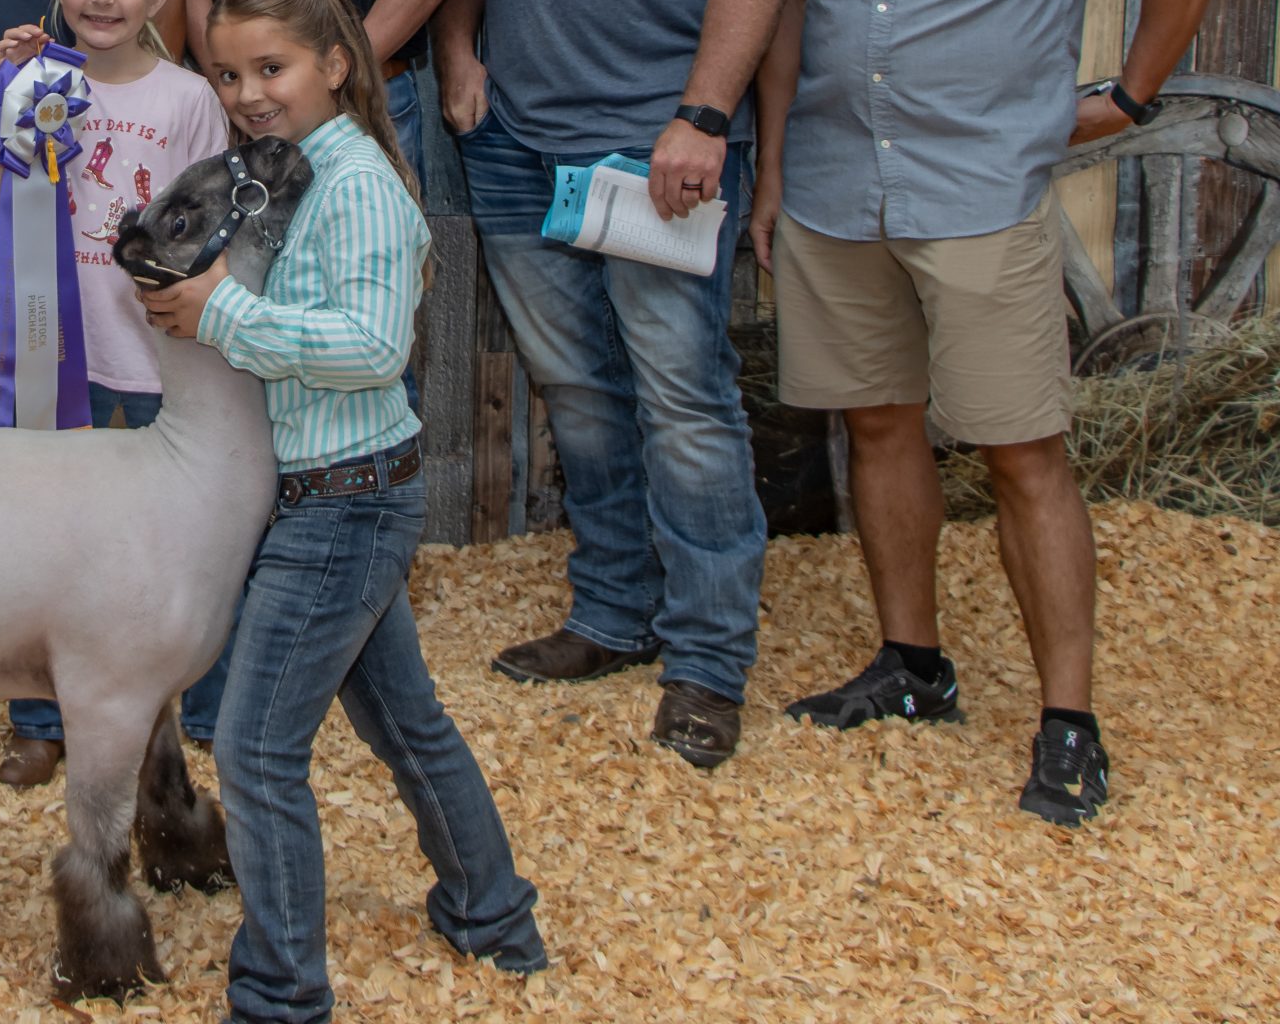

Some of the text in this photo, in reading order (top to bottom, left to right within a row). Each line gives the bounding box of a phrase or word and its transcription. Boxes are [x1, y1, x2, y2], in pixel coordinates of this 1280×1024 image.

[106, 118, 135, 132] DAY
[137, 124, 156, 140] IS
[156, 136, 168, 149] A
[27, 294, 38, 353] PURCHASER
[37, 295, 47, 348] LIVESTOCK
